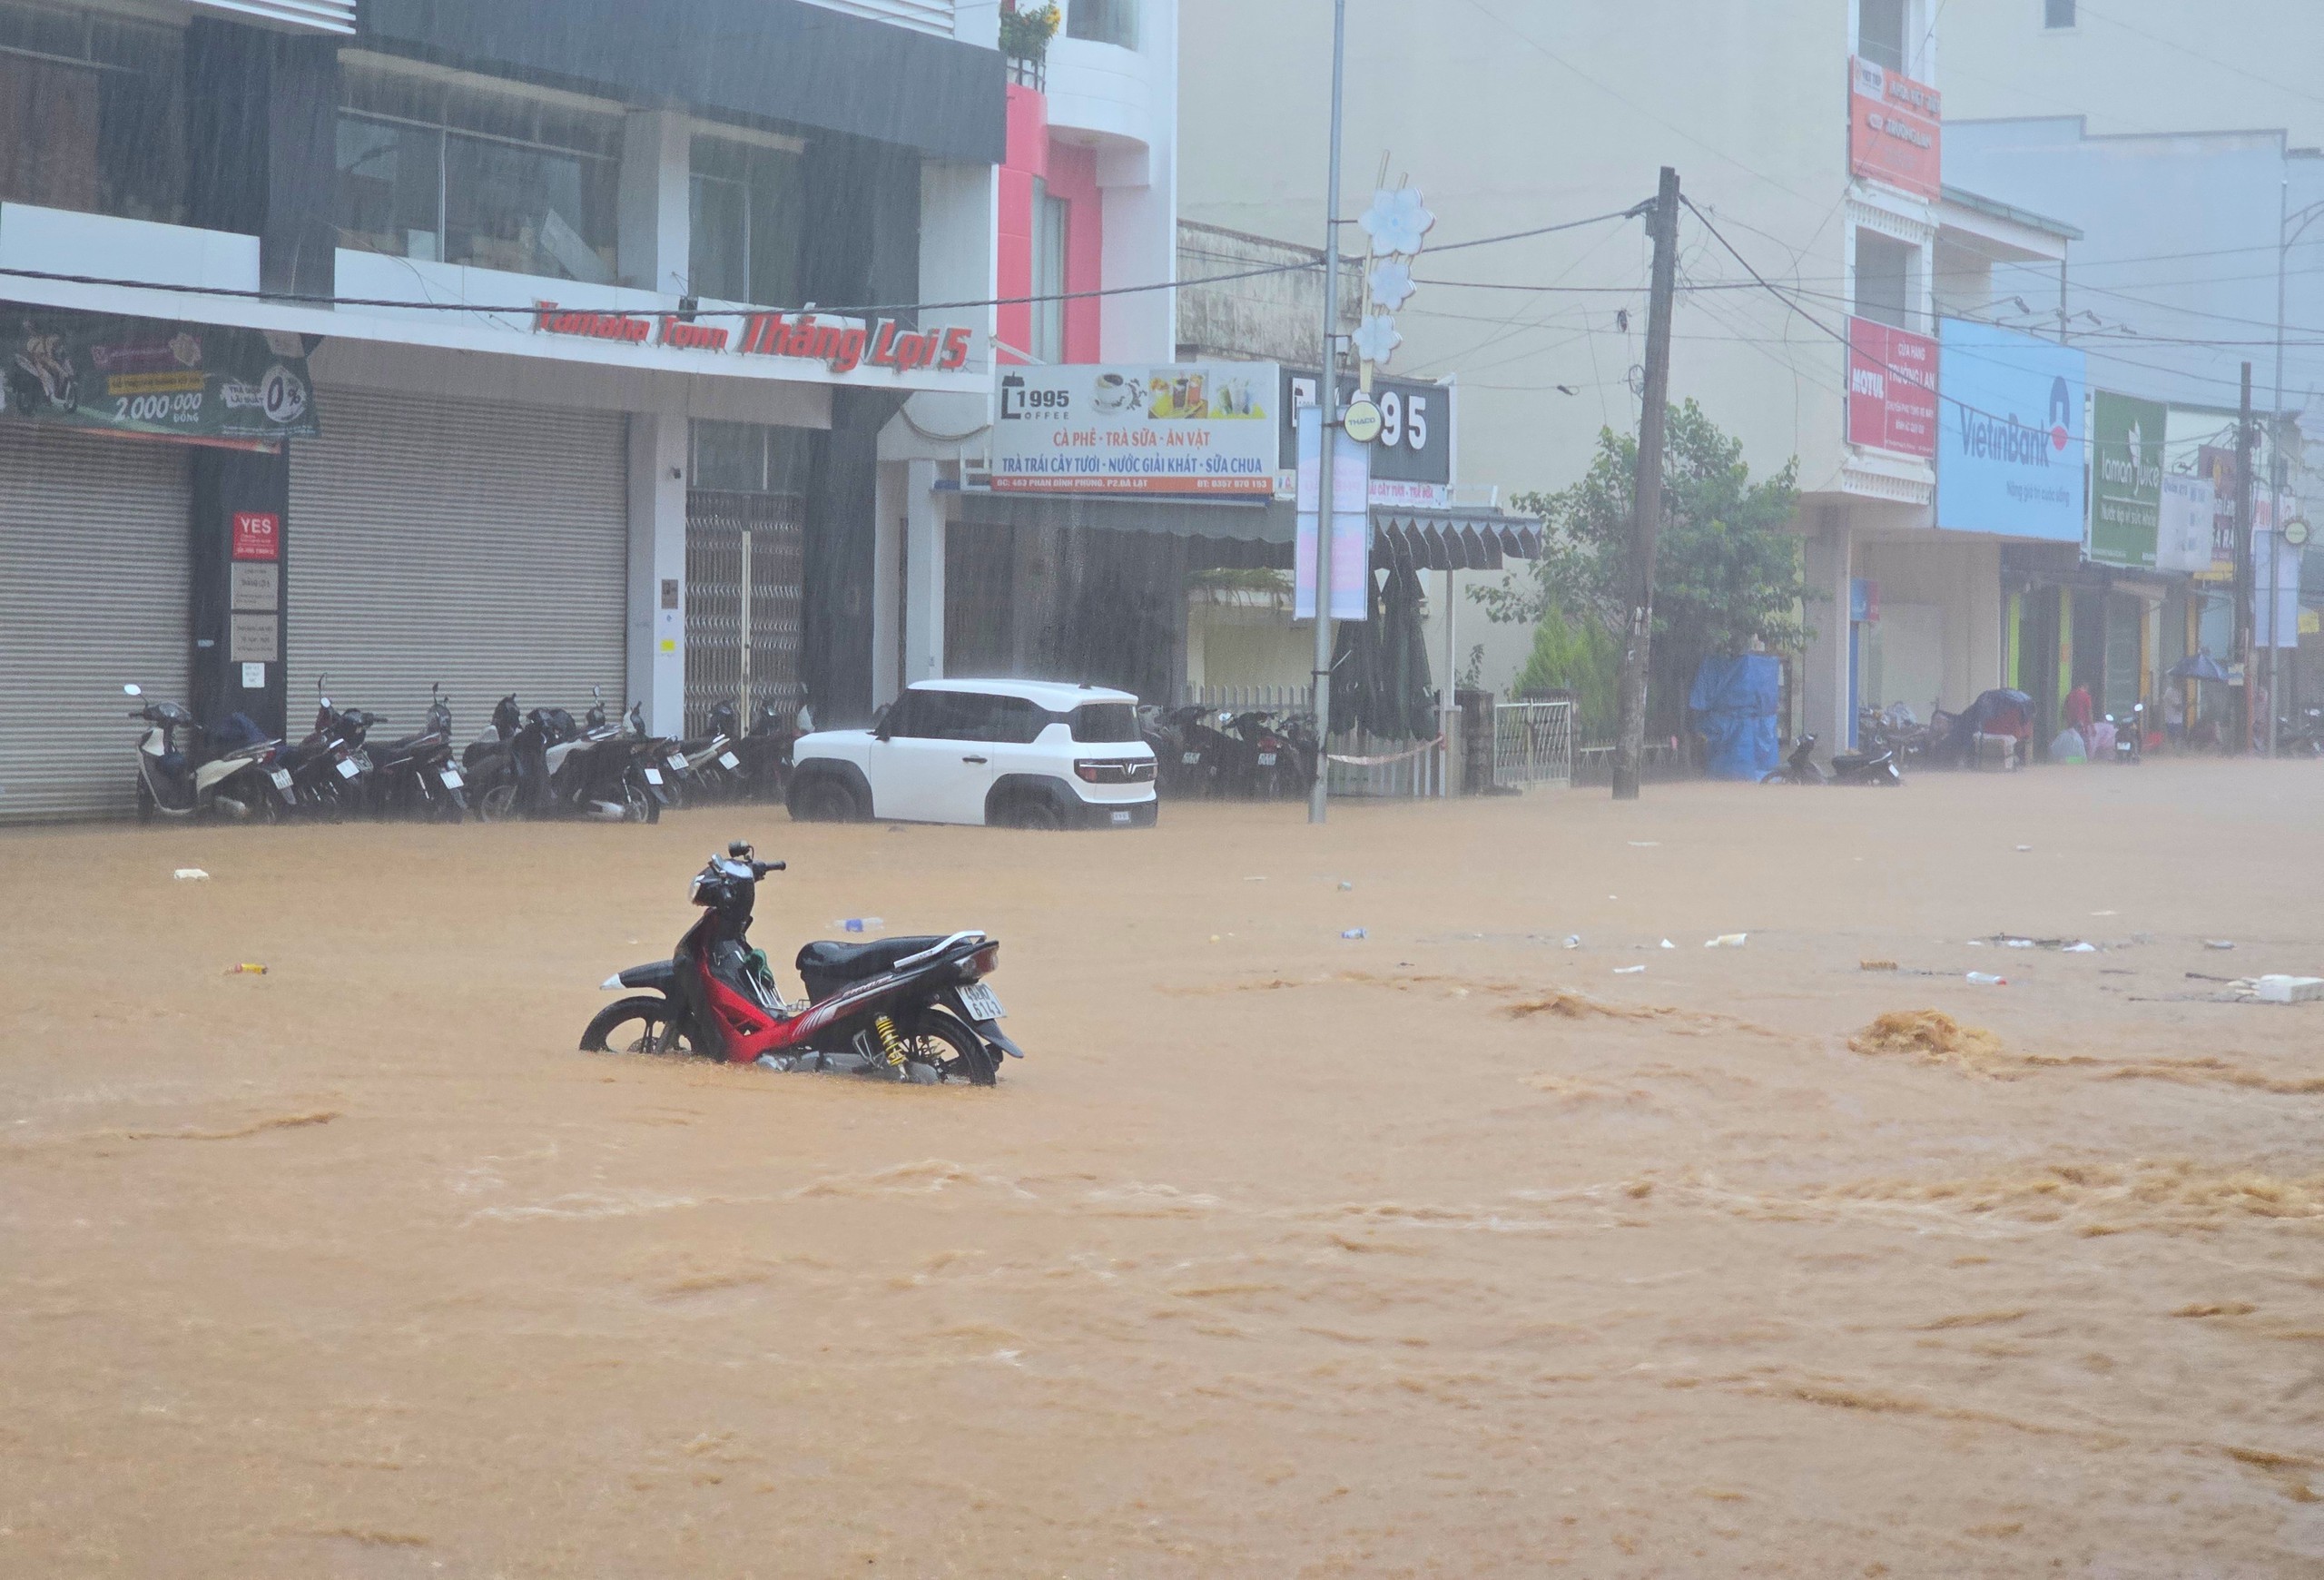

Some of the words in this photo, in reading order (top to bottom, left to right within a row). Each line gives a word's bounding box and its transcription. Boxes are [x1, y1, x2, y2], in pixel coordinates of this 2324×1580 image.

[660, 314, 729, 351] Town
[940, 327, 972, 369] 5
[1852, 368, 1885, 399] MOTUL
[1016, 390, 1070, 408] 1995
[1348, 417, 1376, 426] THACO
[1053, 427, 1069, 447] CÀ
[1073, 427, 1097, 447] PHÊ
[1106, 427, 1128, 447] TRÀ
[1132, 428, 1157, 447] SỮA
[1187, 428, 1210, 449] VẶT
[1959, 404, 2050, 468] VietinBank
[1002, 455, 1023, 473] TRÀ
[1025, 455, 1049, 473] TRÁI
[1050, 454, 1073, 473] CÂY
[1074, 456, 1100, 473] TƯƠI
[1108, 453, 1140, 473] NƯỚC
[1143, 455, 1165, 473] GIẢI
[1167, 455, 1197, 473] KHÁT
[1206, 454, 1228, 473] SỮA
[1230, 458, 1263, 473] CHUA
[240, 518, 271, 534] YES
